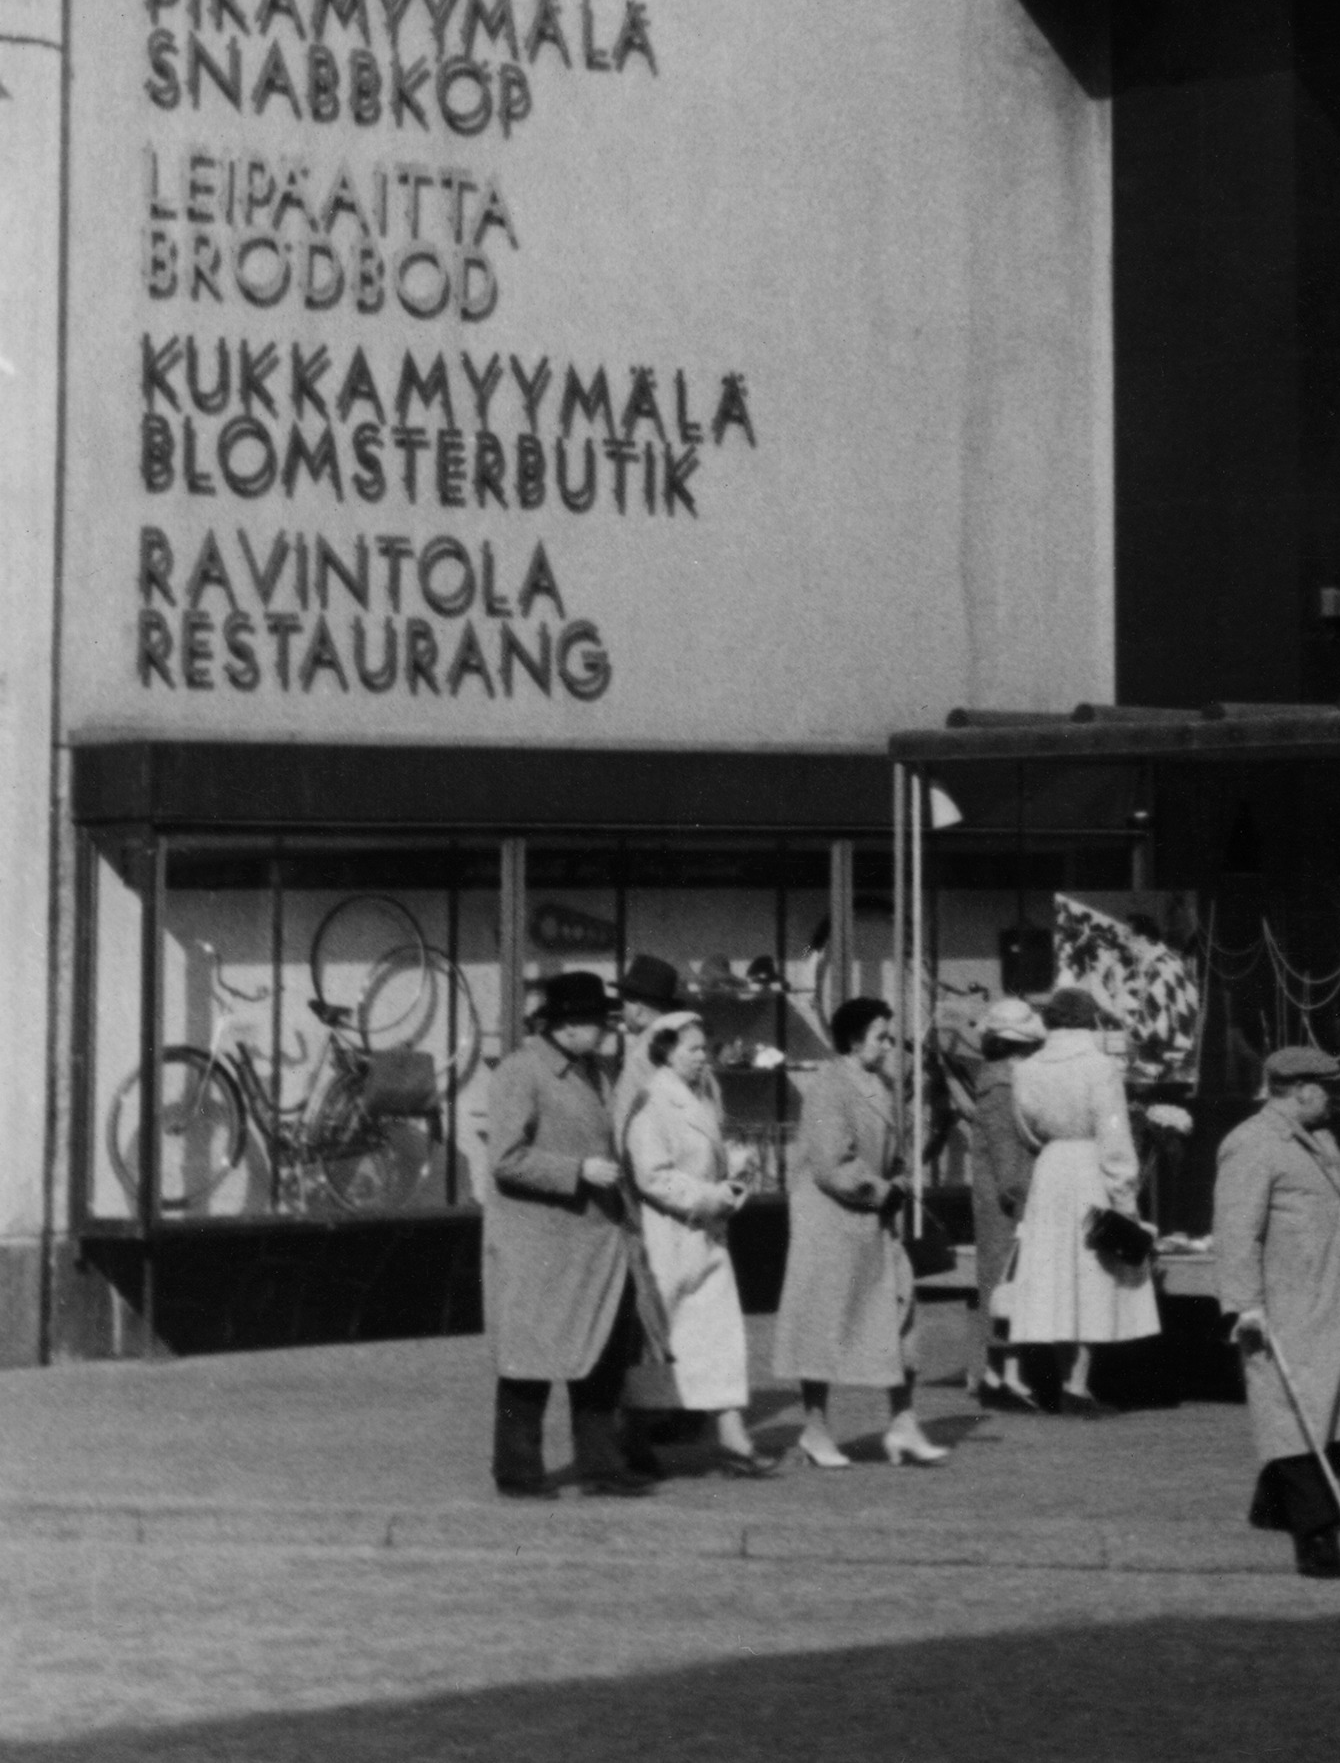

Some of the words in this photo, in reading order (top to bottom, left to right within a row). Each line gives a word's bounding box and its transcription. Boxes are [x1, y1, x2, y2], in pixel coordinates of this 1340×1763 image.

[143, 29, 533, 138] SNABBKÖP
[148, 231, 499, 323] BRÖDBOD
[140, 333, 756, 449] KUKKAMYYMÄLÄ
[140, 413, 700, 519] BLOMSTERBUTIK
[138, 527, 566, 621] RAVINTOLA
[138, 609, 613, 702] RESTAURANG
